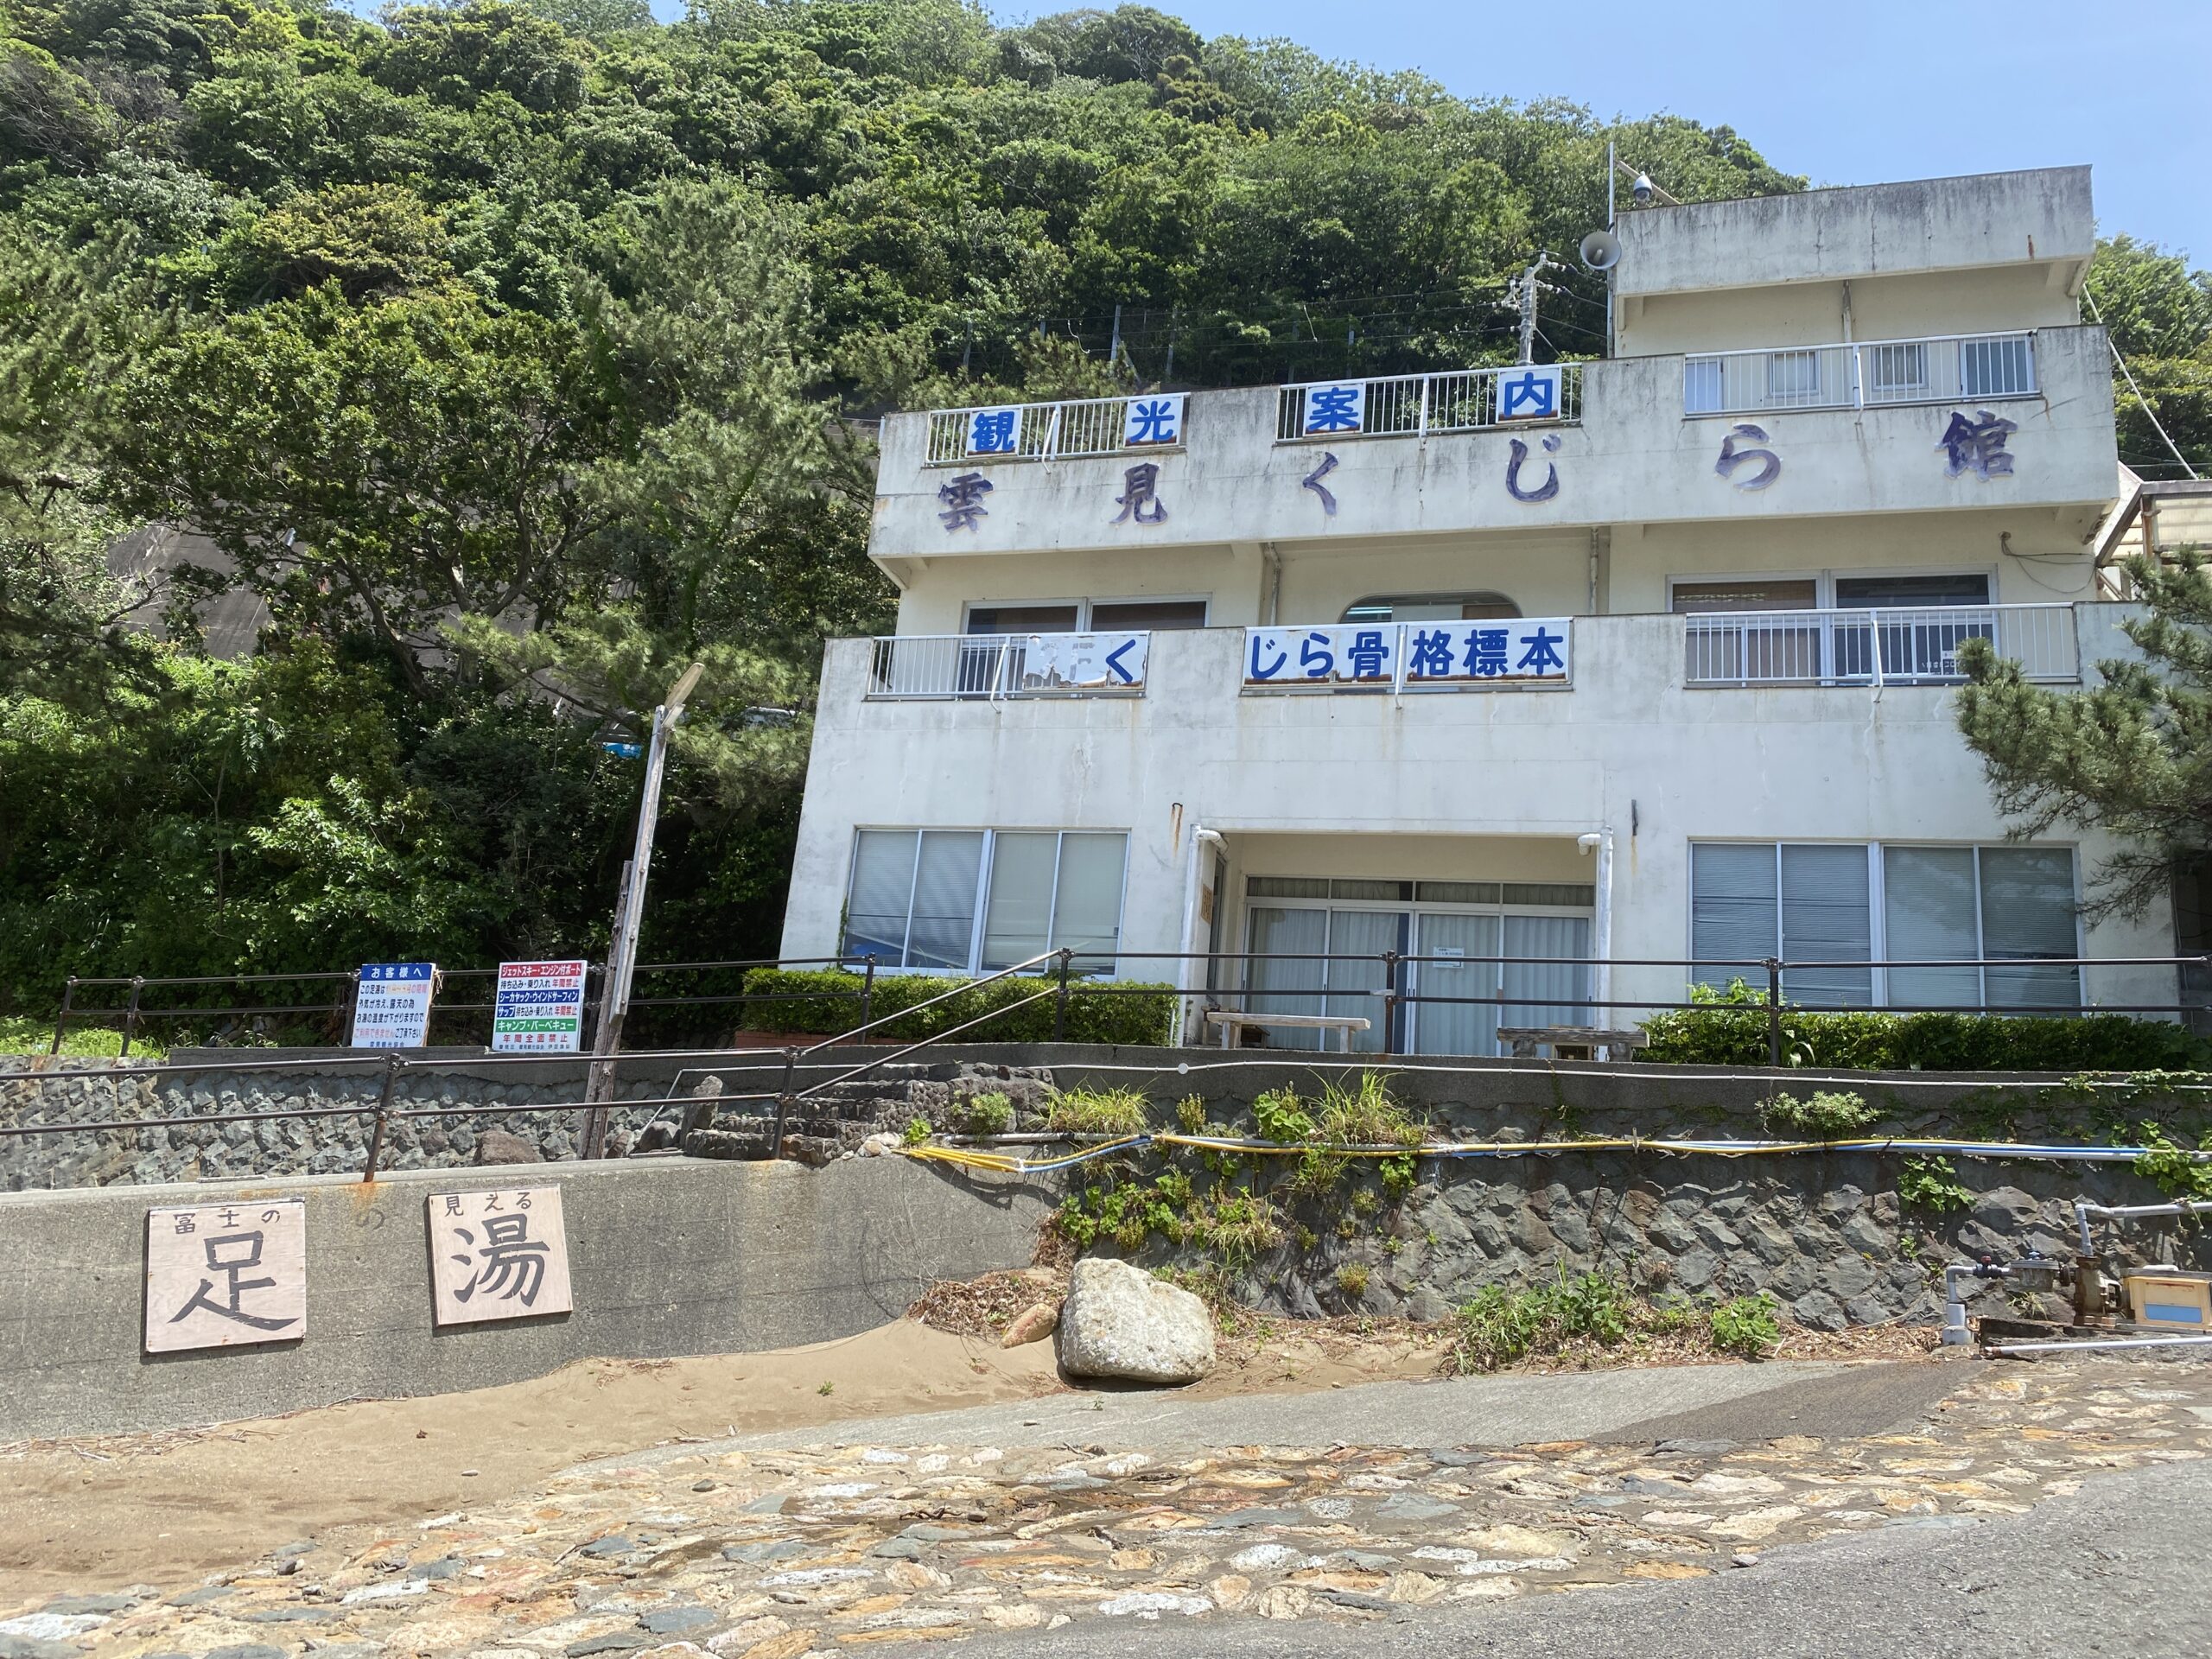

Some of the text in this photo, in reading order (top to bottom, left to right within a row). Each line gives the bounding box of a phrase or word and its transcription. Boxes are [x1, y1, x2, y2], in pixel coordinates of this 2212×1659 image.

[970, 372, 1554, 454] 観光案内
[938, 410, 2018, 532] 雲見くじら館
[371, 966, 423, 979] お客様へ
[502, 964, 581, 977] ジェットスキー・エンジン付ボート
[552, 978, 579, 988] 年間禁止
[498, 1007, 514, 1017] サップ
[555, 1006, 577, 1015] 年間禁止
[498, 1020, 574, 1031] キャンプ・バーベキュー
[503, 1033, 568, 1043] 年間全面禁止
[445, 1192, 532, 1218] 見える
[450, 1213, 550, 1307] 湯
[168, 1230, 301, 1332] 足
